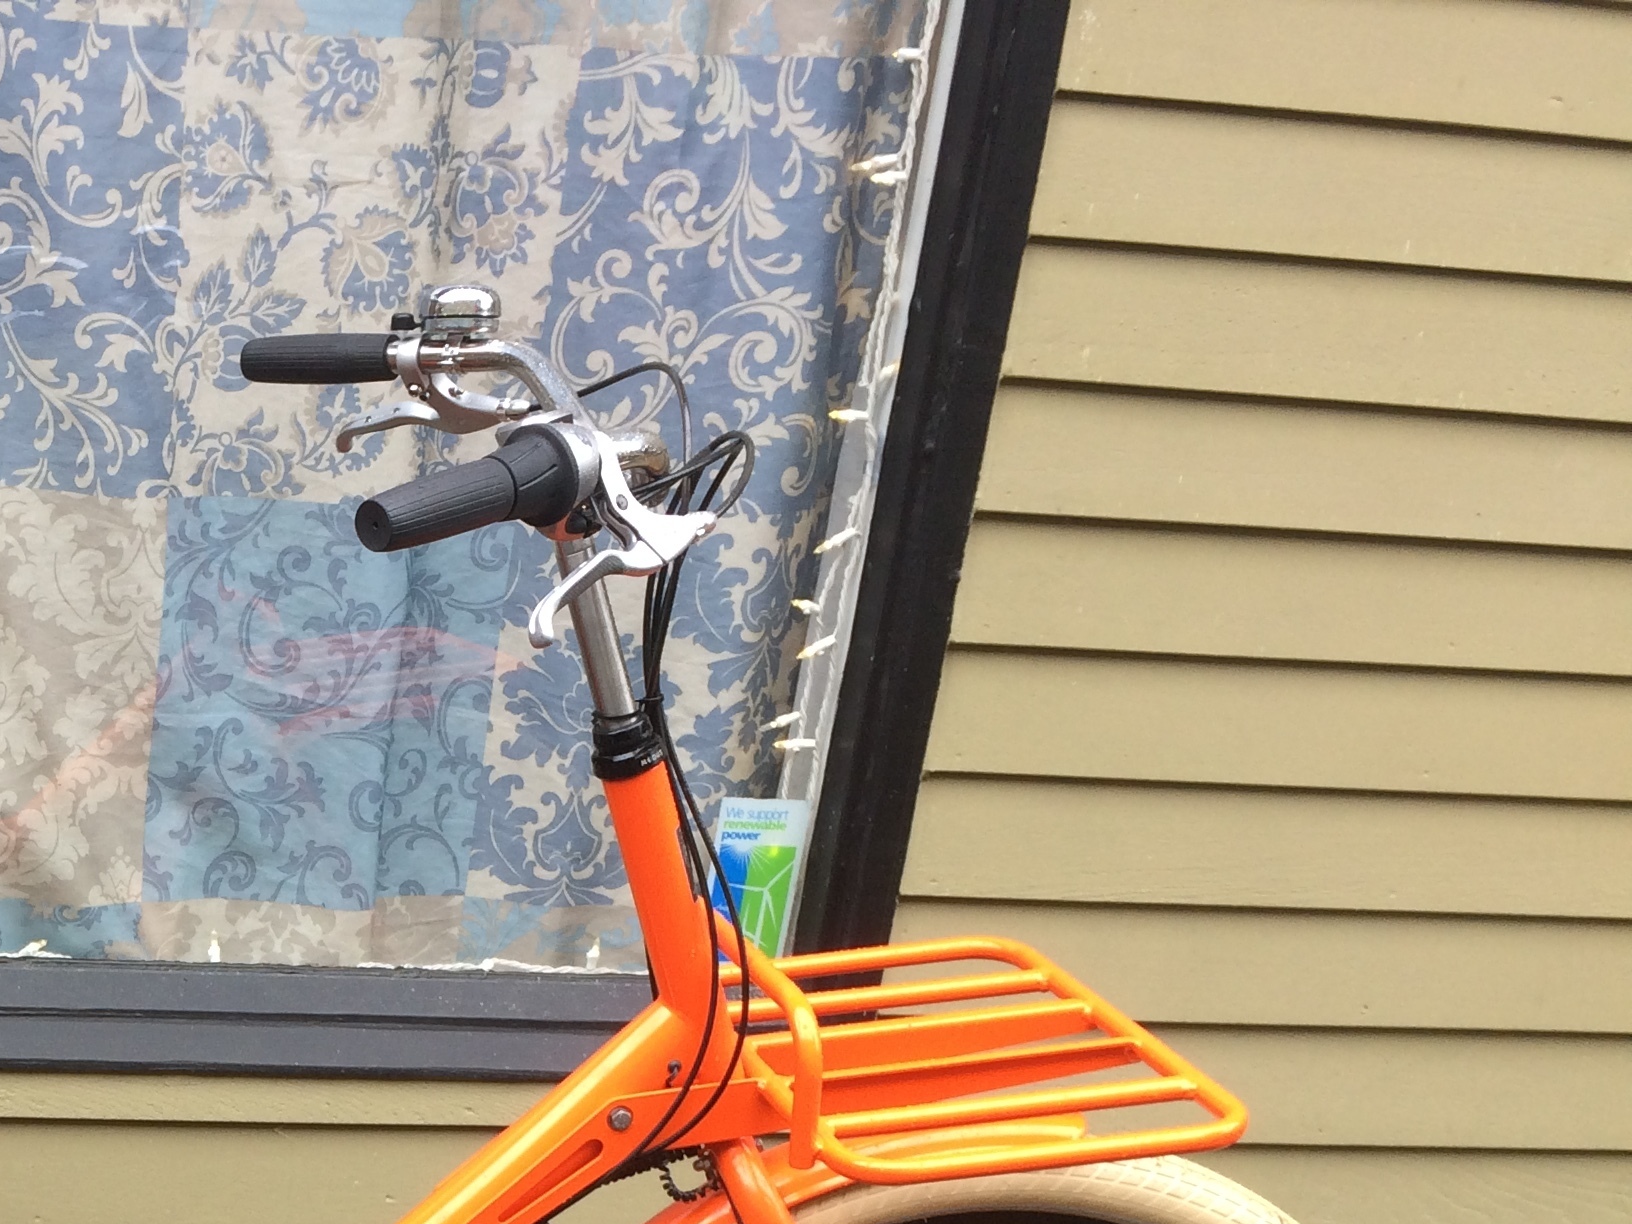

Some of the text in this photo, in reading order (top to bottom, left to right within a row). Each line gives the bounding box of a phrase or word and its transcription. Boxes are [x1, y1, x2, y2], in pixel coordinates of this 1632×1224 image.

[726, 806, 789, 822] We support
[723, 820, 787, 831] renewable
[720, 831, 761, 842] power
